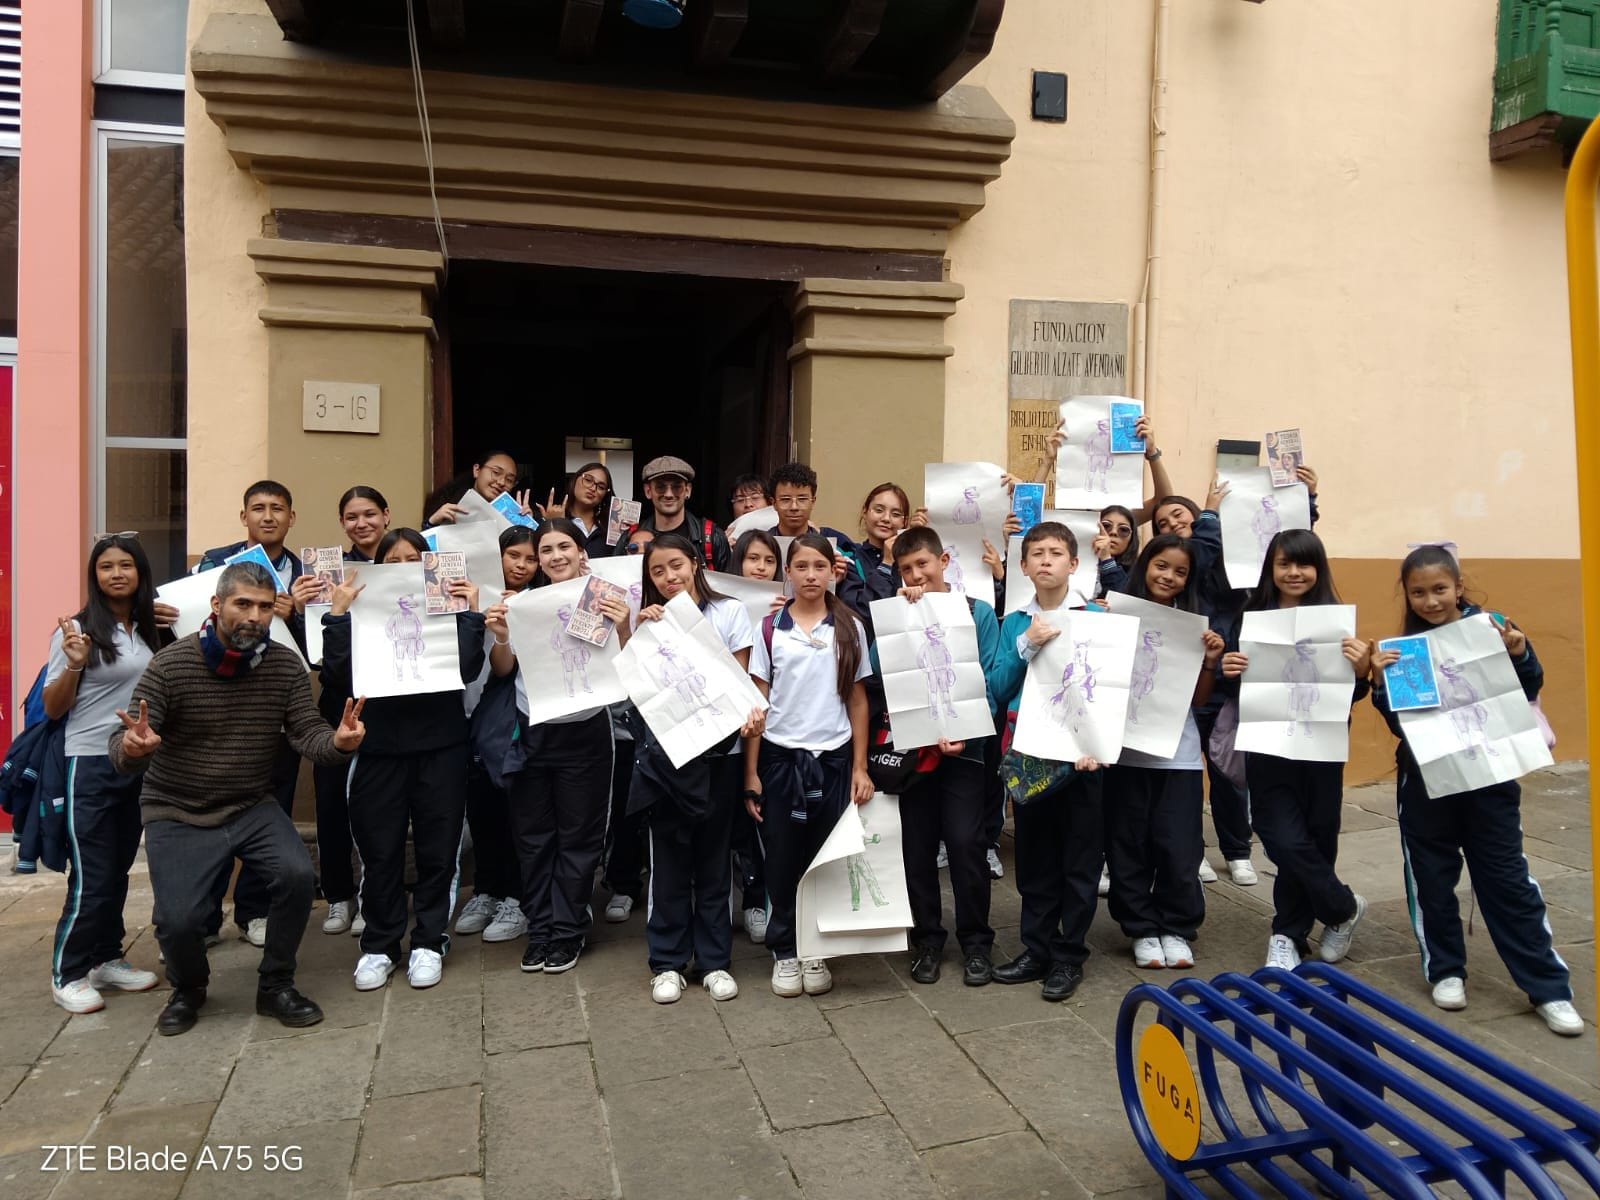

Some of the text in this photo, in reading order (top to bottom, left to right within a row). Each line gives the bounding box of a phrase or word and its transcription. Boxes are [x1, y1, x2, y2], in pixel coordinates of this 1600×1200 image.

[1033, 321, 1105, 343] FUNDACION
[1010, 351, 1125, 378] GILBERTO ALZATE AVENDAÑO
[1144, 1061, 1195, 1124] FUGA
